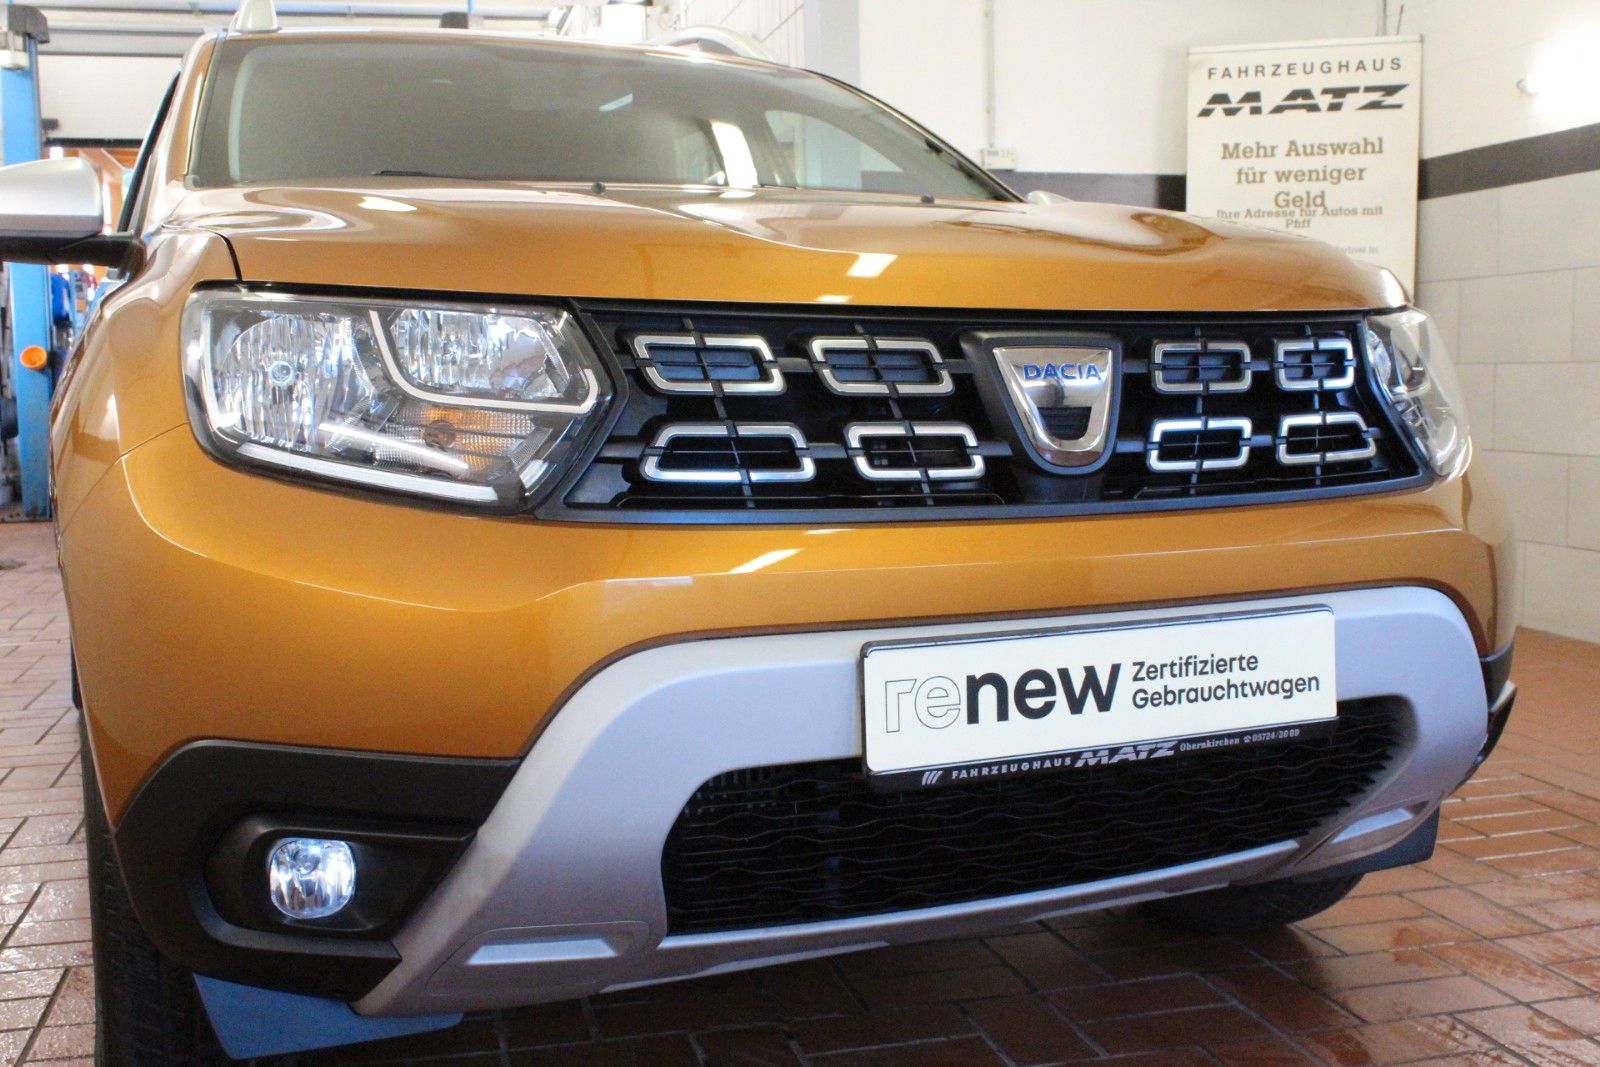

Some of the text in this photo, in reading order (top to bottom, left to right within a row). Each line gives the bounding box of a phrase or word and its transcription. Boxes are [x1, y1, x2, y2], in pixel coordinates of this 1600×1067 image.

[1208, 57, 1402, 79] FAHRZEUGHAUS
[1197, 83, 1409, 117] MATZ
[1221, 137, 1384, 160] Mehr Auswahl
[1236, 164, 1366, 185] für weniger
[1274, 190, 1326, 209] Geld
[1217, 206, 1383, 219] Ihre Adresse für Autos mit
[1285, 218, 1312, 229] Pfiff
[1023, 363, 1102, 380] DACIA
[1131, 654, 1259, 682] Zertifizierte
[884, 663, 1121, 734] renew
[1132, 673, 1320, 709] Gebrauchtwagen
[951, 757, 1072, 780] FAHRZEUGHAUS
[1074, 740, 1179, 768] MATZ
[1180, 737, 1240, 752] Obernkirchen
